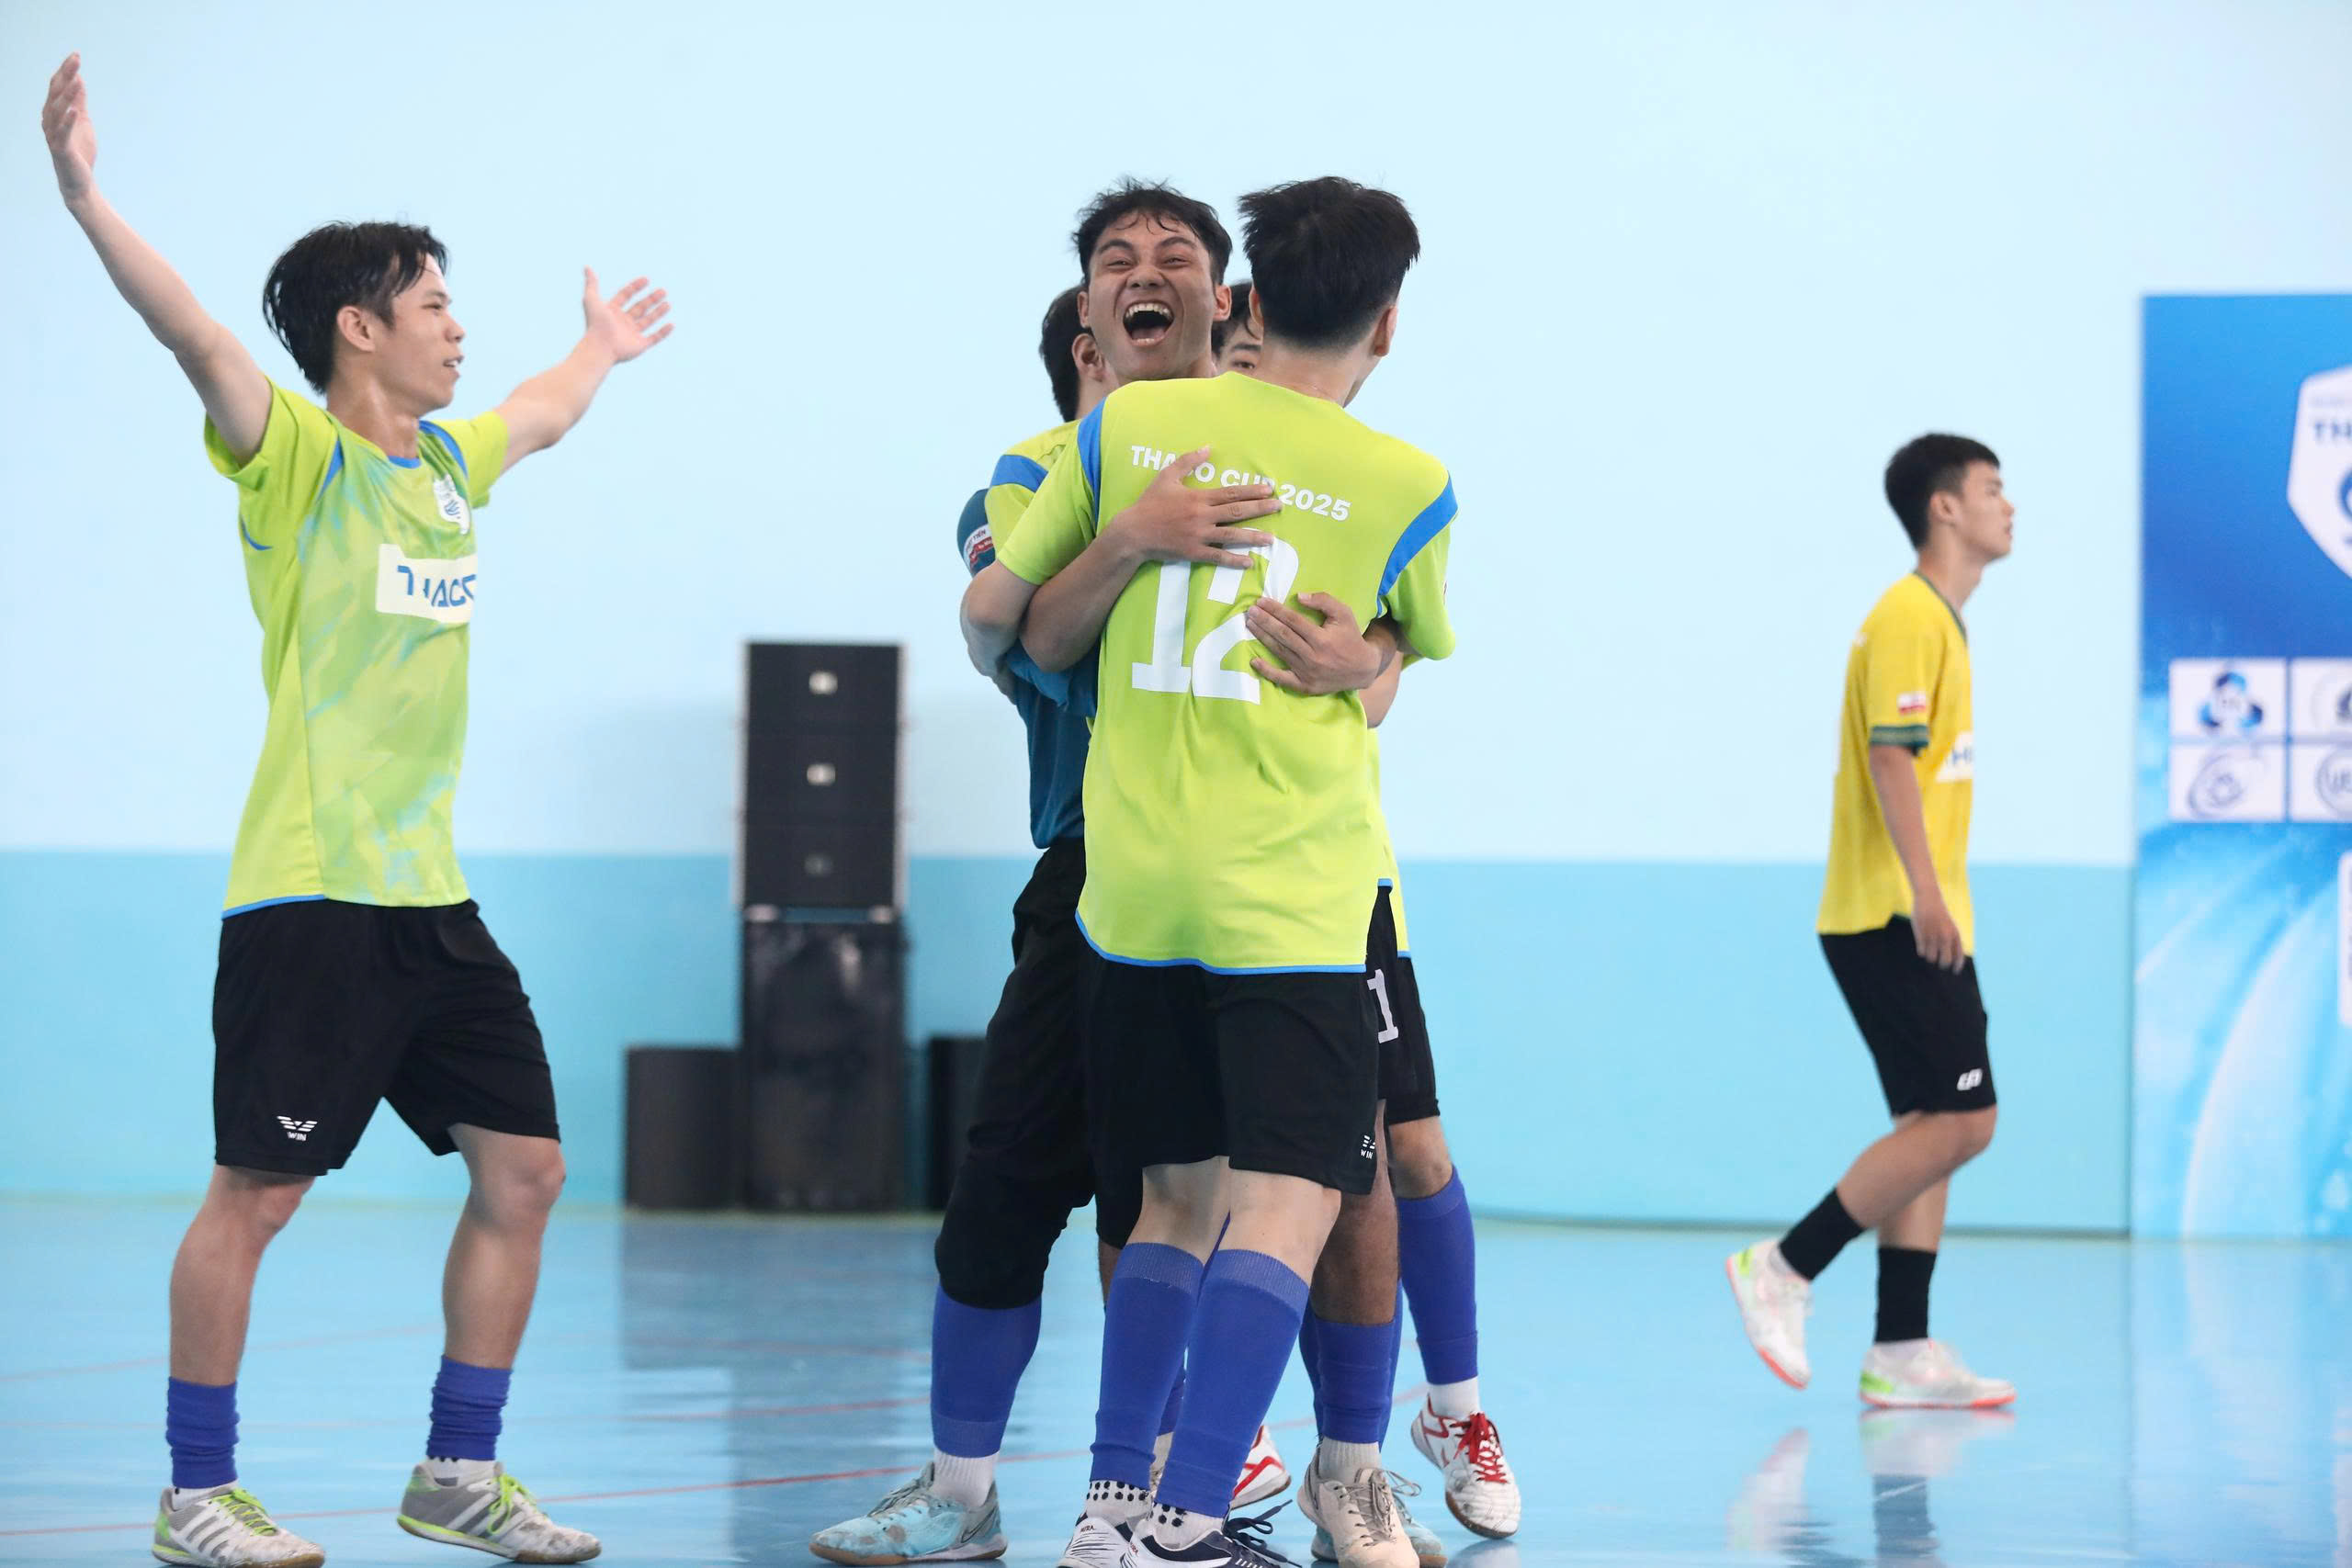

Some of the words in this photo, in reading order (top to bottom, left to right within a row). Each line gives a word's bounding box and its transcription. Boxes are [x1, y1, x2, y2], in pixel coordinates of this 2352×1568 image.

[1131, 445, 1216, 483] THAO
[1278, 483, 1351, 521] 2025
[1132, 527, 1299, 705] 12
[287, 1131, 307, 1142] WIN
[1361, 1149, 1373, 1159] WIN
